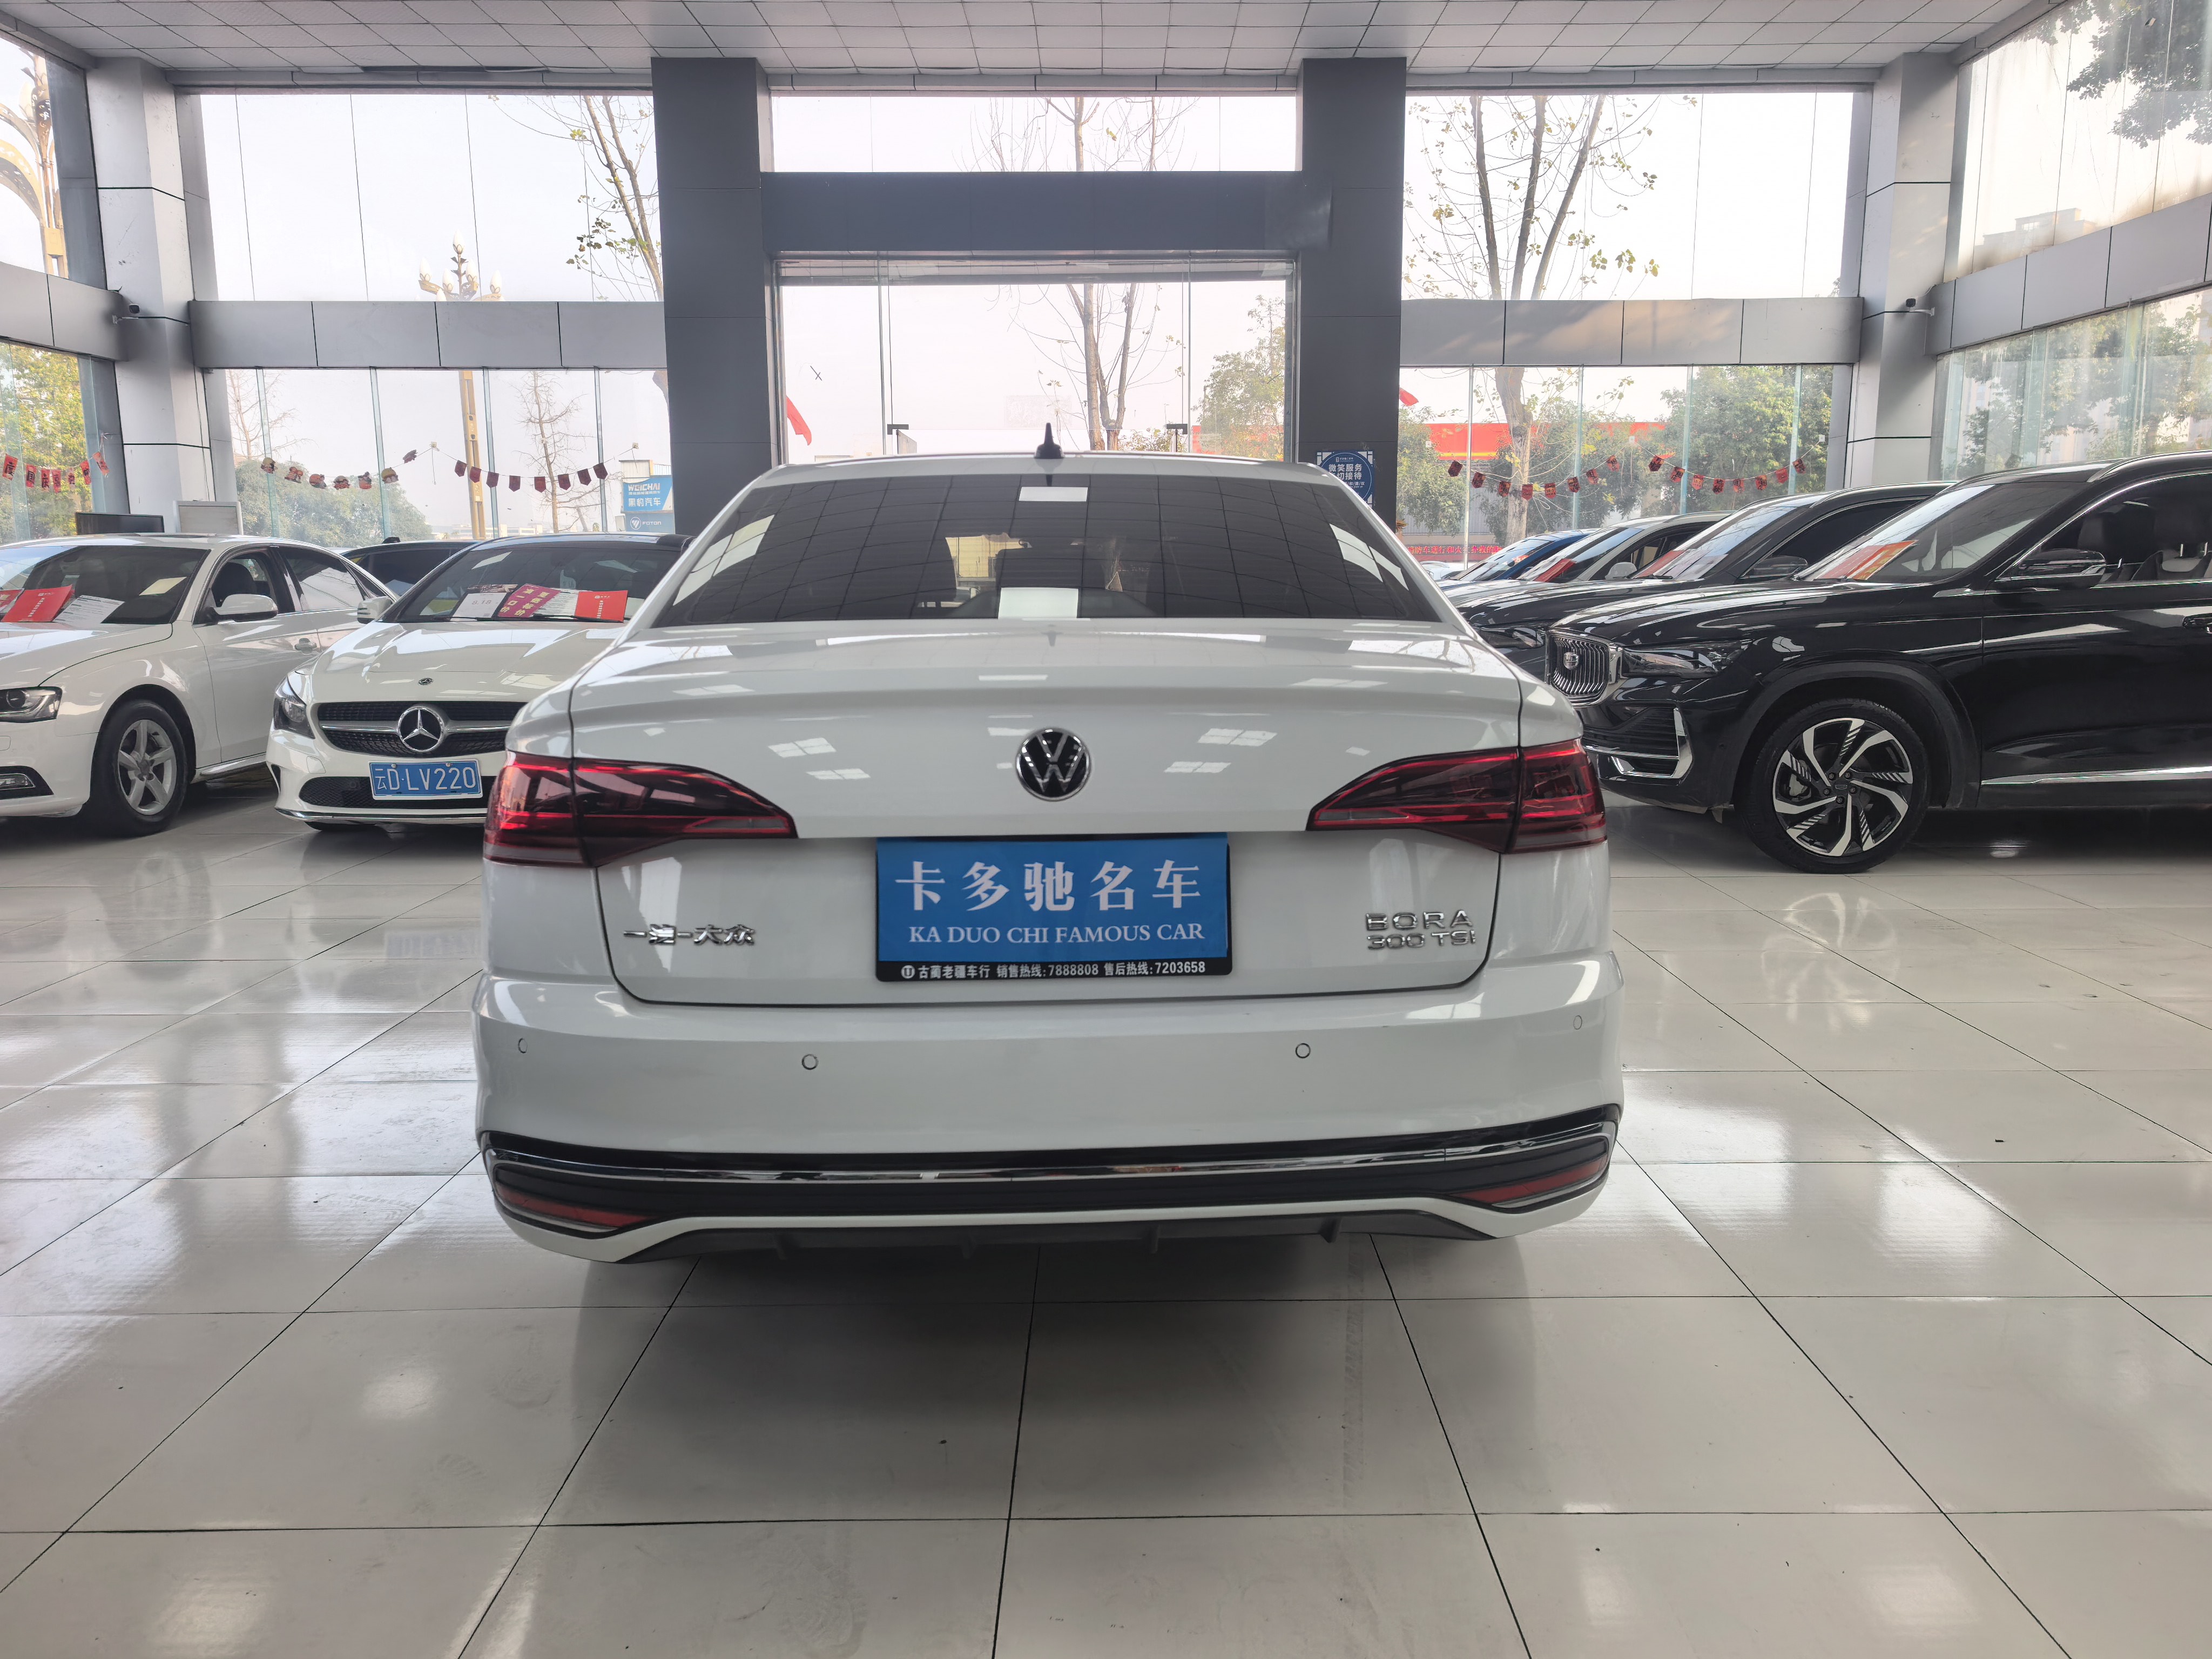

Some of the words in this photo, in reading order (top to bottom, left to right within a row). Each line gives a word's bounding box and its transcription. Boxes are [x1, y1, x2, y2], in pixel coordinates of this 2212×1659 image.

[1328, 463, 1362, 472] 微笑服务
[1330, 472, 1362, 480] 切接待
[628, 483, 660, 491] WEICHAI
[628, 497, 661, 507] 黑豹汽车
[895, 860, 1201, 912] 卡多驰名车
[1366, 909, 1473, 930] BORA
[909, 926, 941, 943] KA
[948, 926, 1001, 943] DUO
[1006, 926, 1049, 943] CHI
[1055, 925, 1151, 942] FAMOUS
[1156, 923, 1205, 941] CAR
[1431, 929, 1476, 946] TSI
